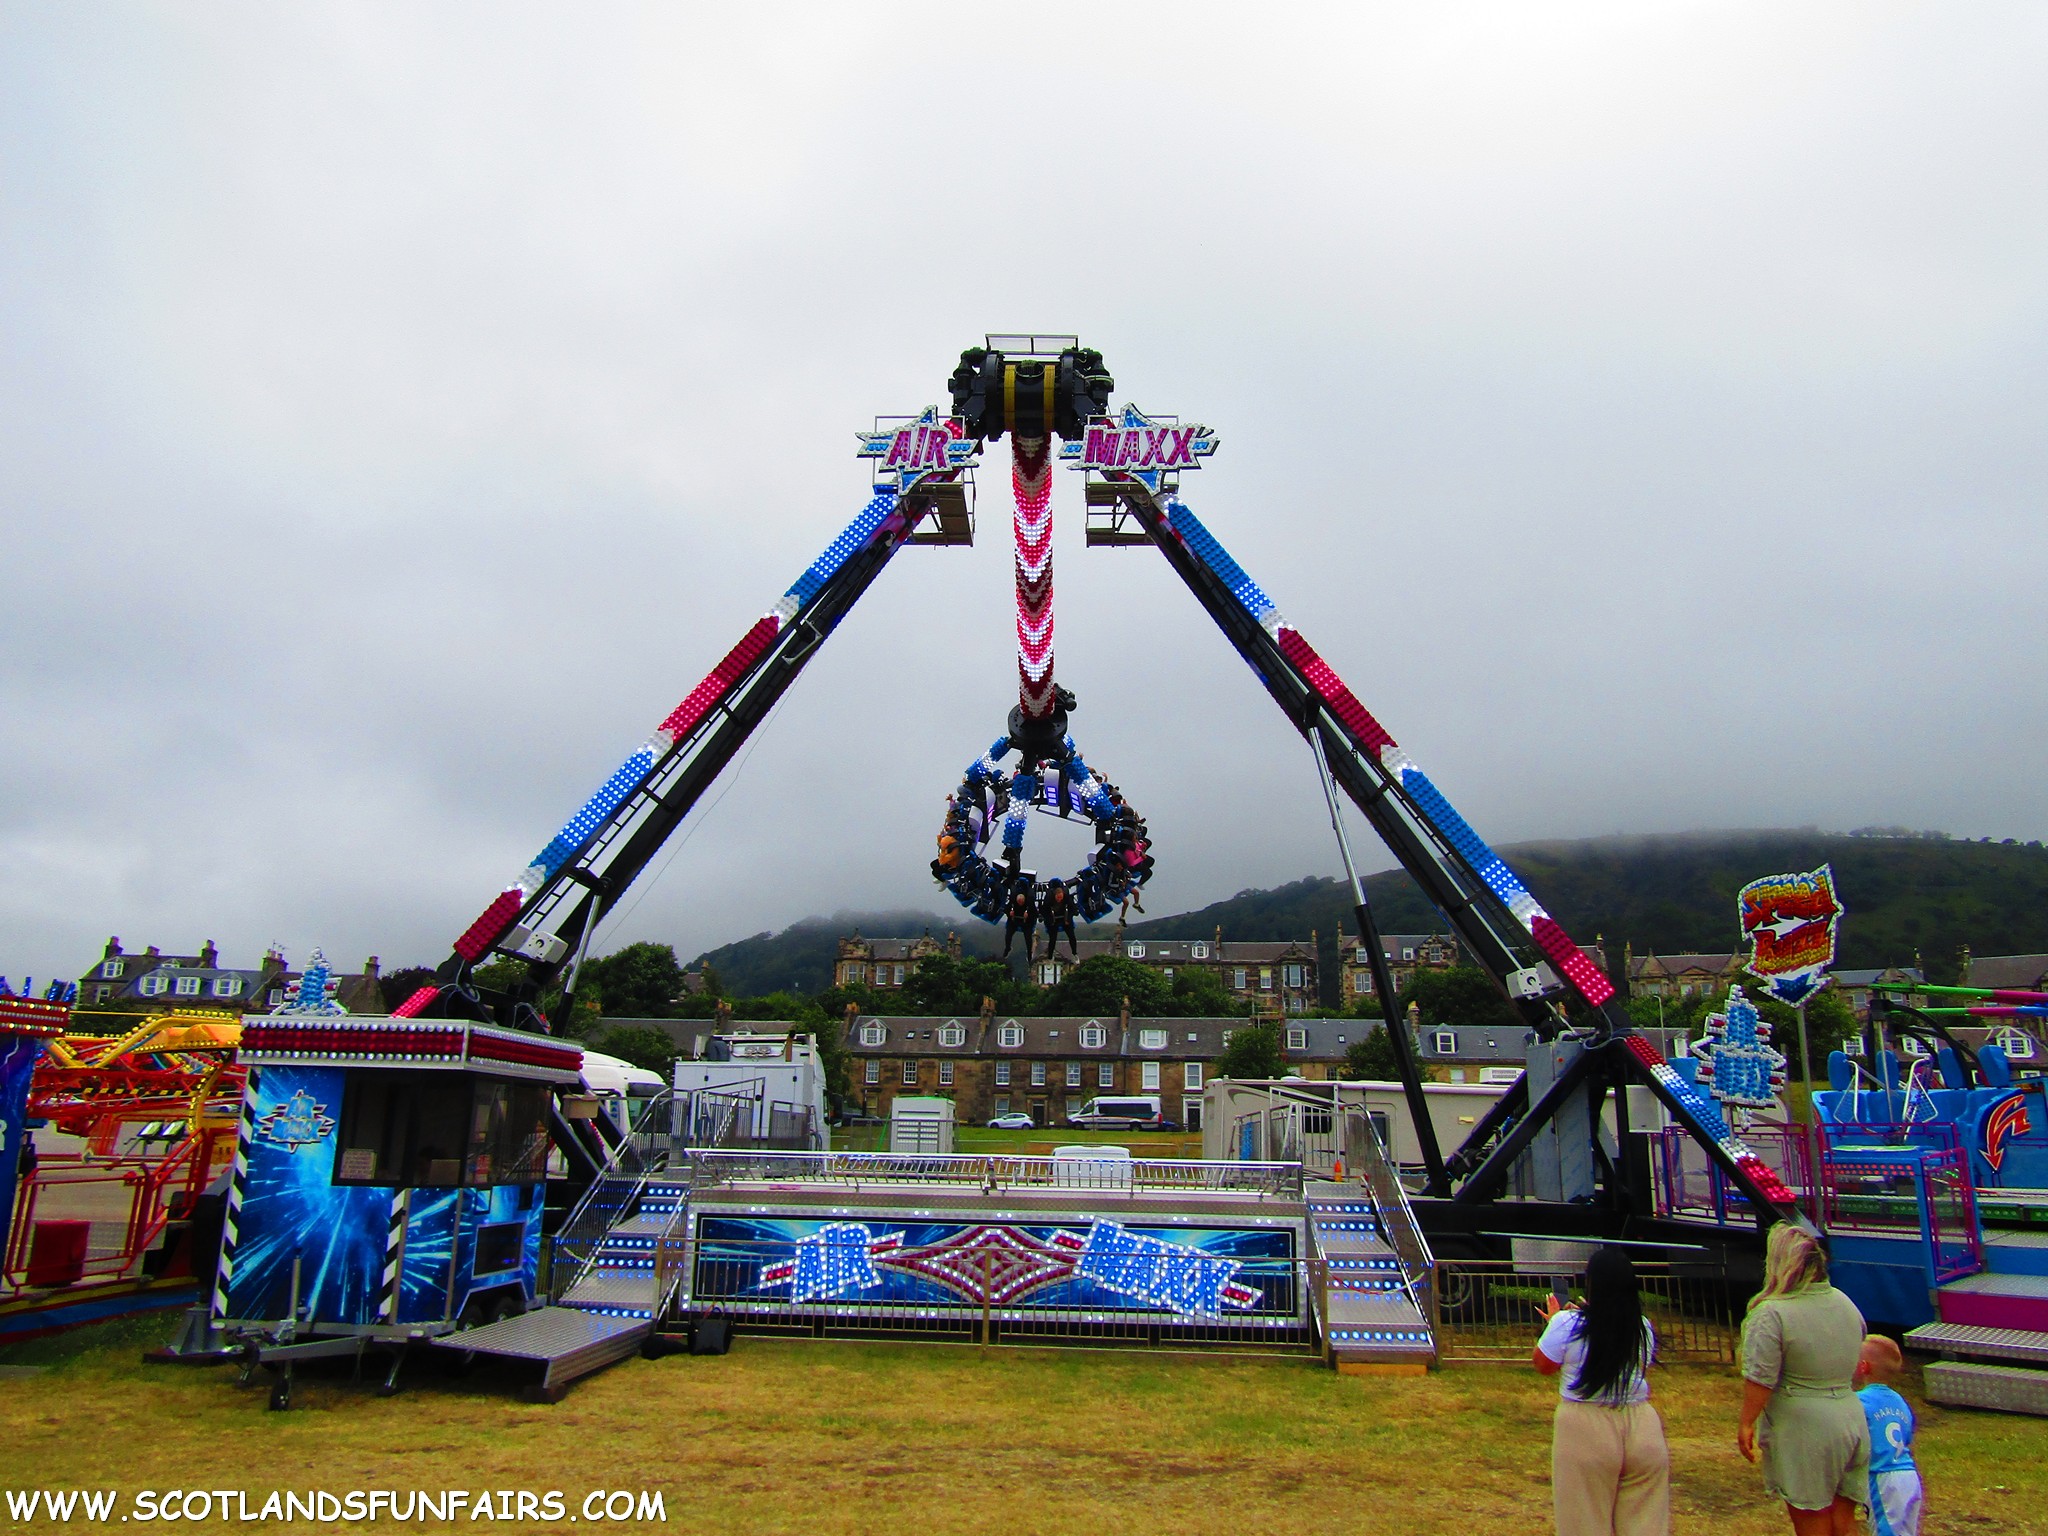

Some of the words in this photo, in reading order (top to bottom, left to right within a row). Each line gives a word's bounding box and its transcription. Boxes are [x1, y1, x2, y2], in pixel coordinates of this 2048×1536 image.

[885, 426, 949, 468] AIR
[1083, 427, 1196, 467] MAXX
[1885, 1422, 1905, 1461] 9
